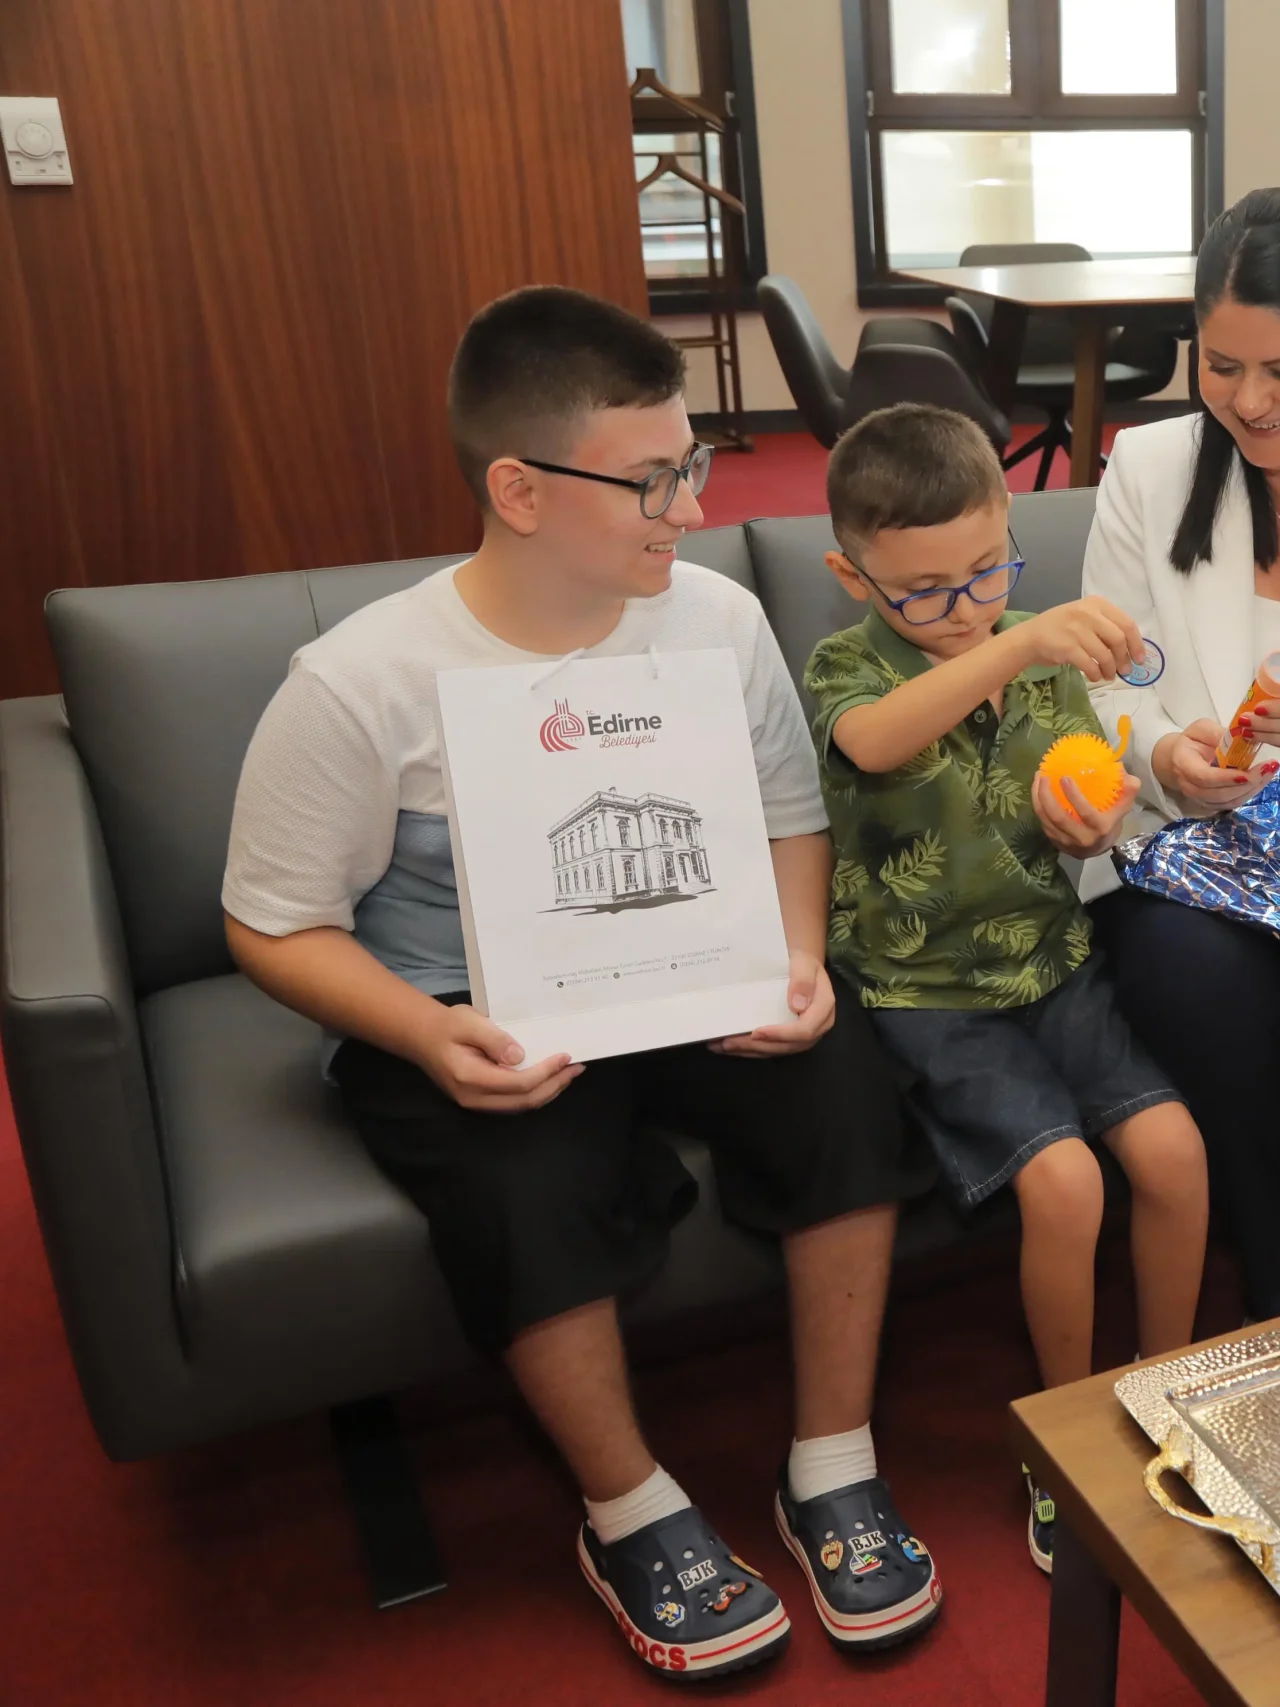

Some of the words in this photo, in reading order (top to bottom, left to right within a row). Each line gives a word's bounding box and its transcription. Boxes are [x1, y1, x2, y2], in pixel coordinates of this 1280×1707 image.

[587, 713, 663, 735] Edirne
[599, 732, 657, 748] Belediyesi
[851, 1532, 883, 1551] BJK
[680, 1561, 715, 1587] BJK
